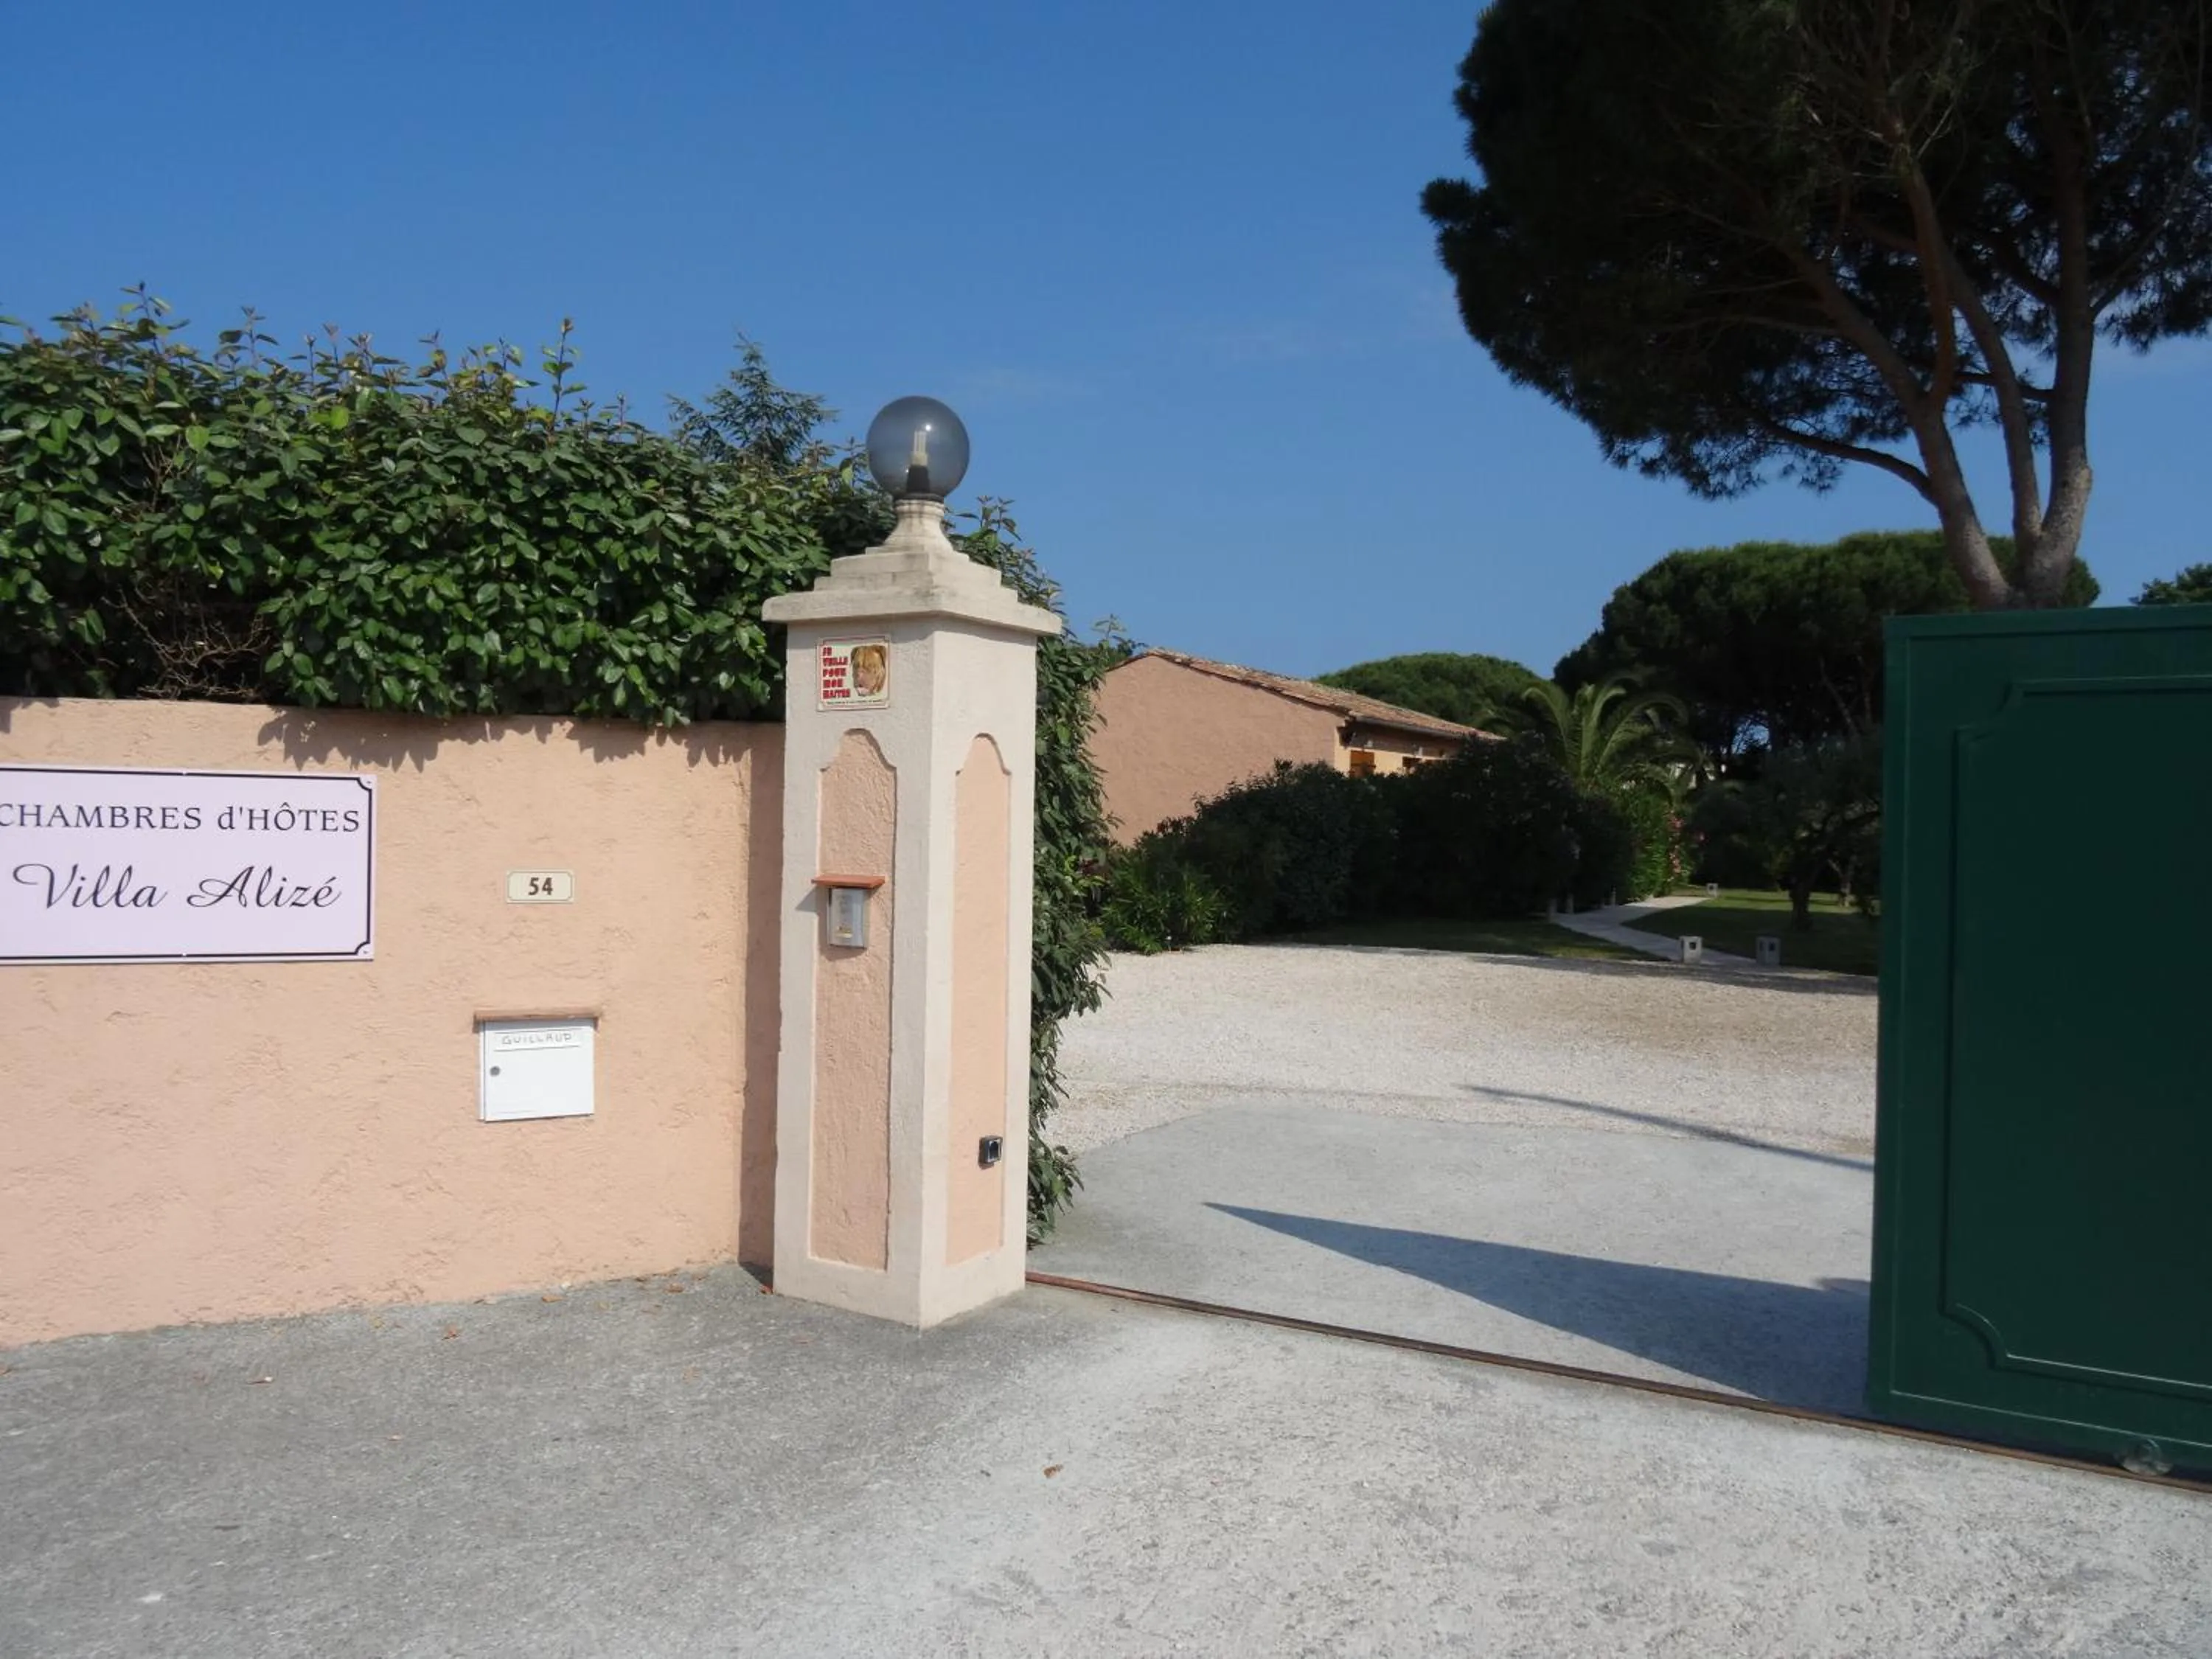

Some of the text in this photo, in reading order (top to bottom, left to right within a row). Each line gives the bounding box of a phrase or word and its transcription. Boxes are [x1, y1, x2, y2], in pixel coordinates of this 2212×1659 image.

[0, 801, 360, 832] CHAMBRES d'HÔTES
[12, 863, 342, 909] Villa Alizé
[528, 876, 554, 896] 54
